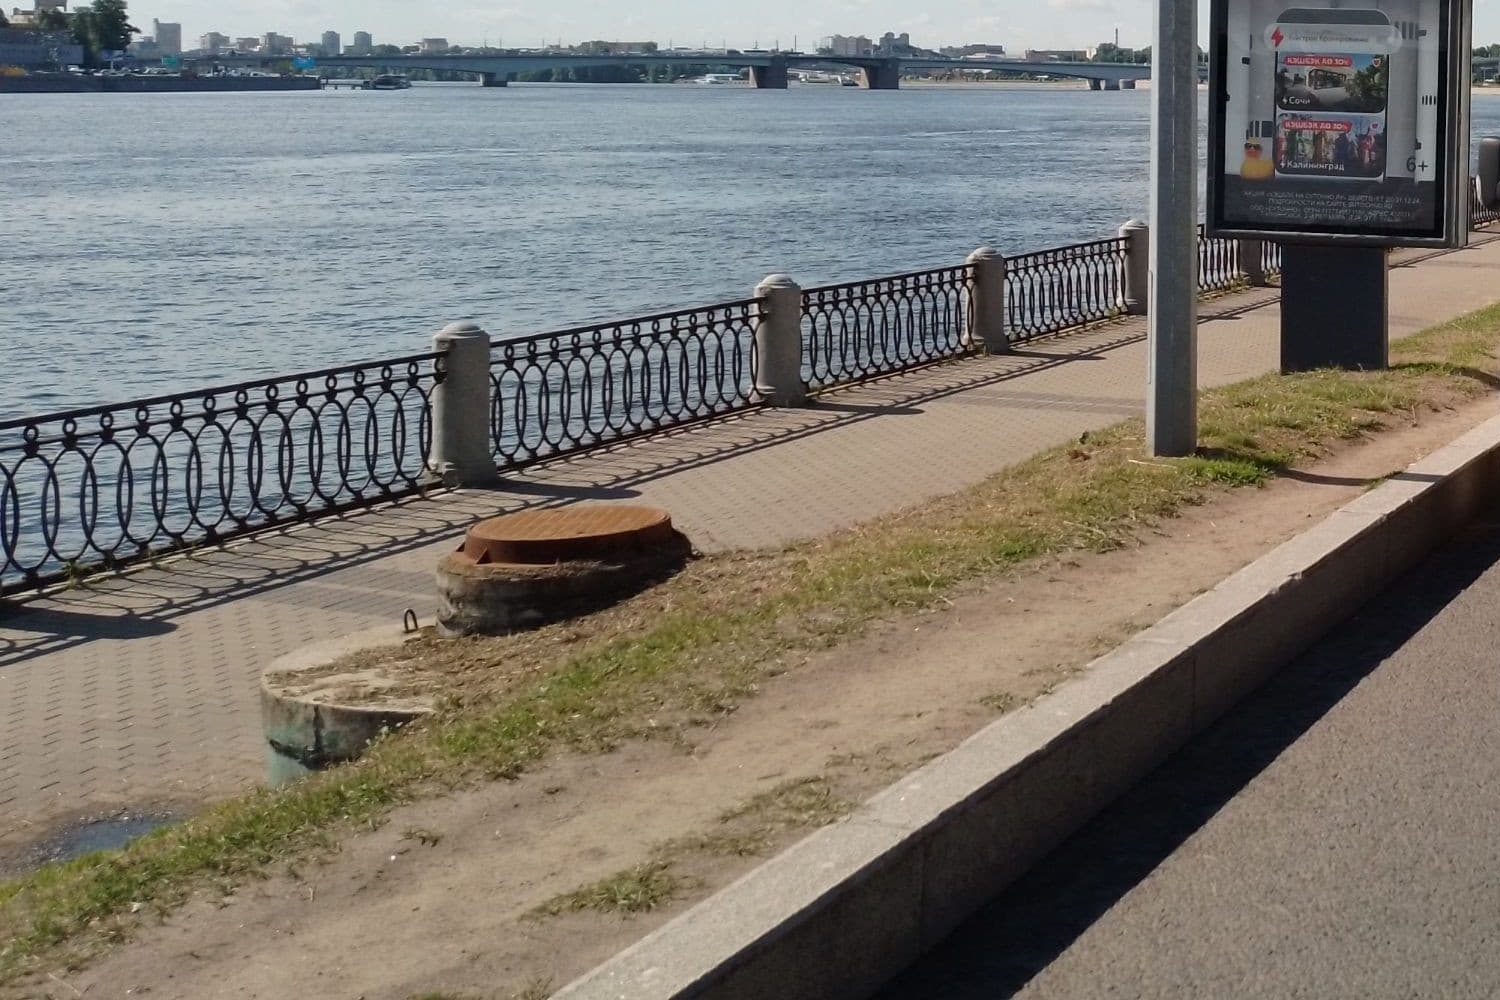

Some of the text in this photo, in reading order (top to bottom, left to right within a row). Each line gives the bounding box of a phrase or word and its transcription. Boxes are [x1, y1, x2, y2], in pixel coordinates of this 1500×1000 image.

[1288, 96, 1311, 105] Сочи
[1286, 159, 1345, 171] Калининград
[1406, 156, 1429, 173] 6+
